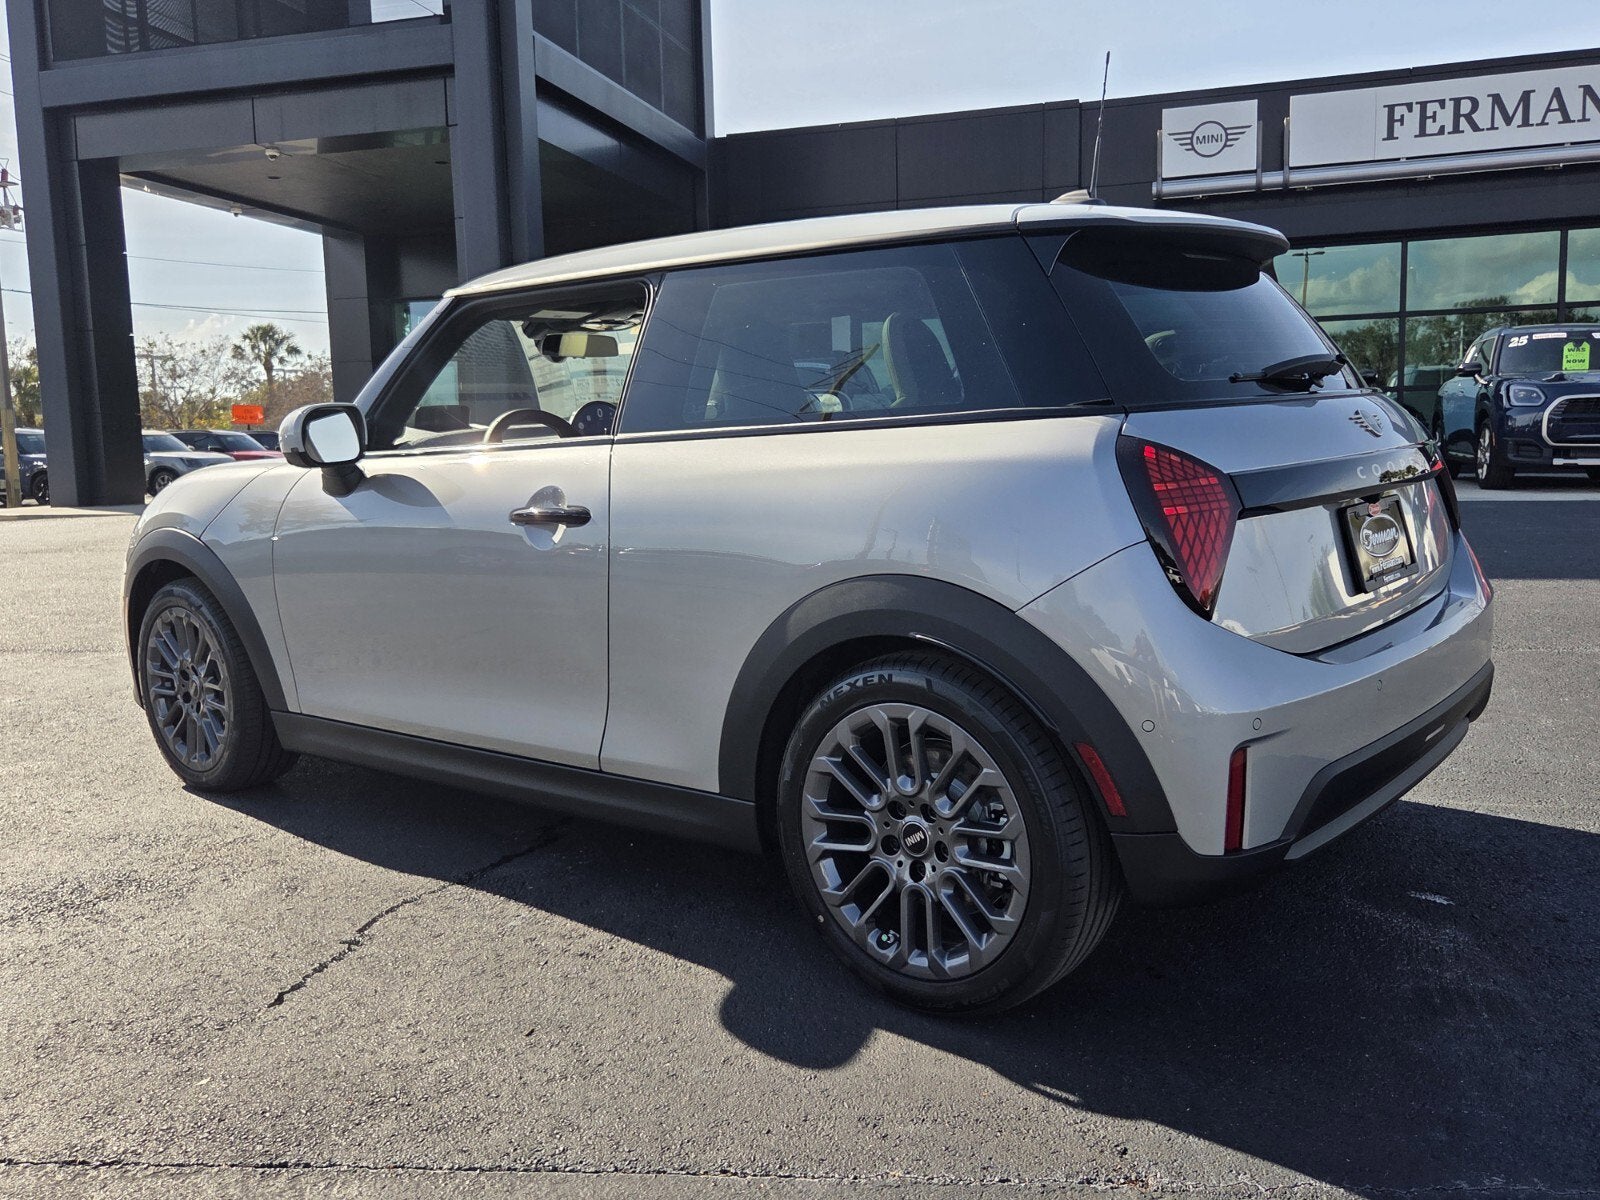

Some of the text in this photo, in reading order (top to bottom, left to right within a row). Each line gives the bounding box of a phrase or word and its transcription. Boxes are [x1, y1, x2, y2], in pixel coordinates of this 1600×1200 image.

[1382, 85, 1600, 141] FERMAN
[1196, 133, 1223, 145] MINI
[1508, 335, 1528, 347] 25
[1356, 456, 1420, 479] COOPE
[818, 673, 893, 710] NEXEN
[905, 830, 925, 847] MINI
